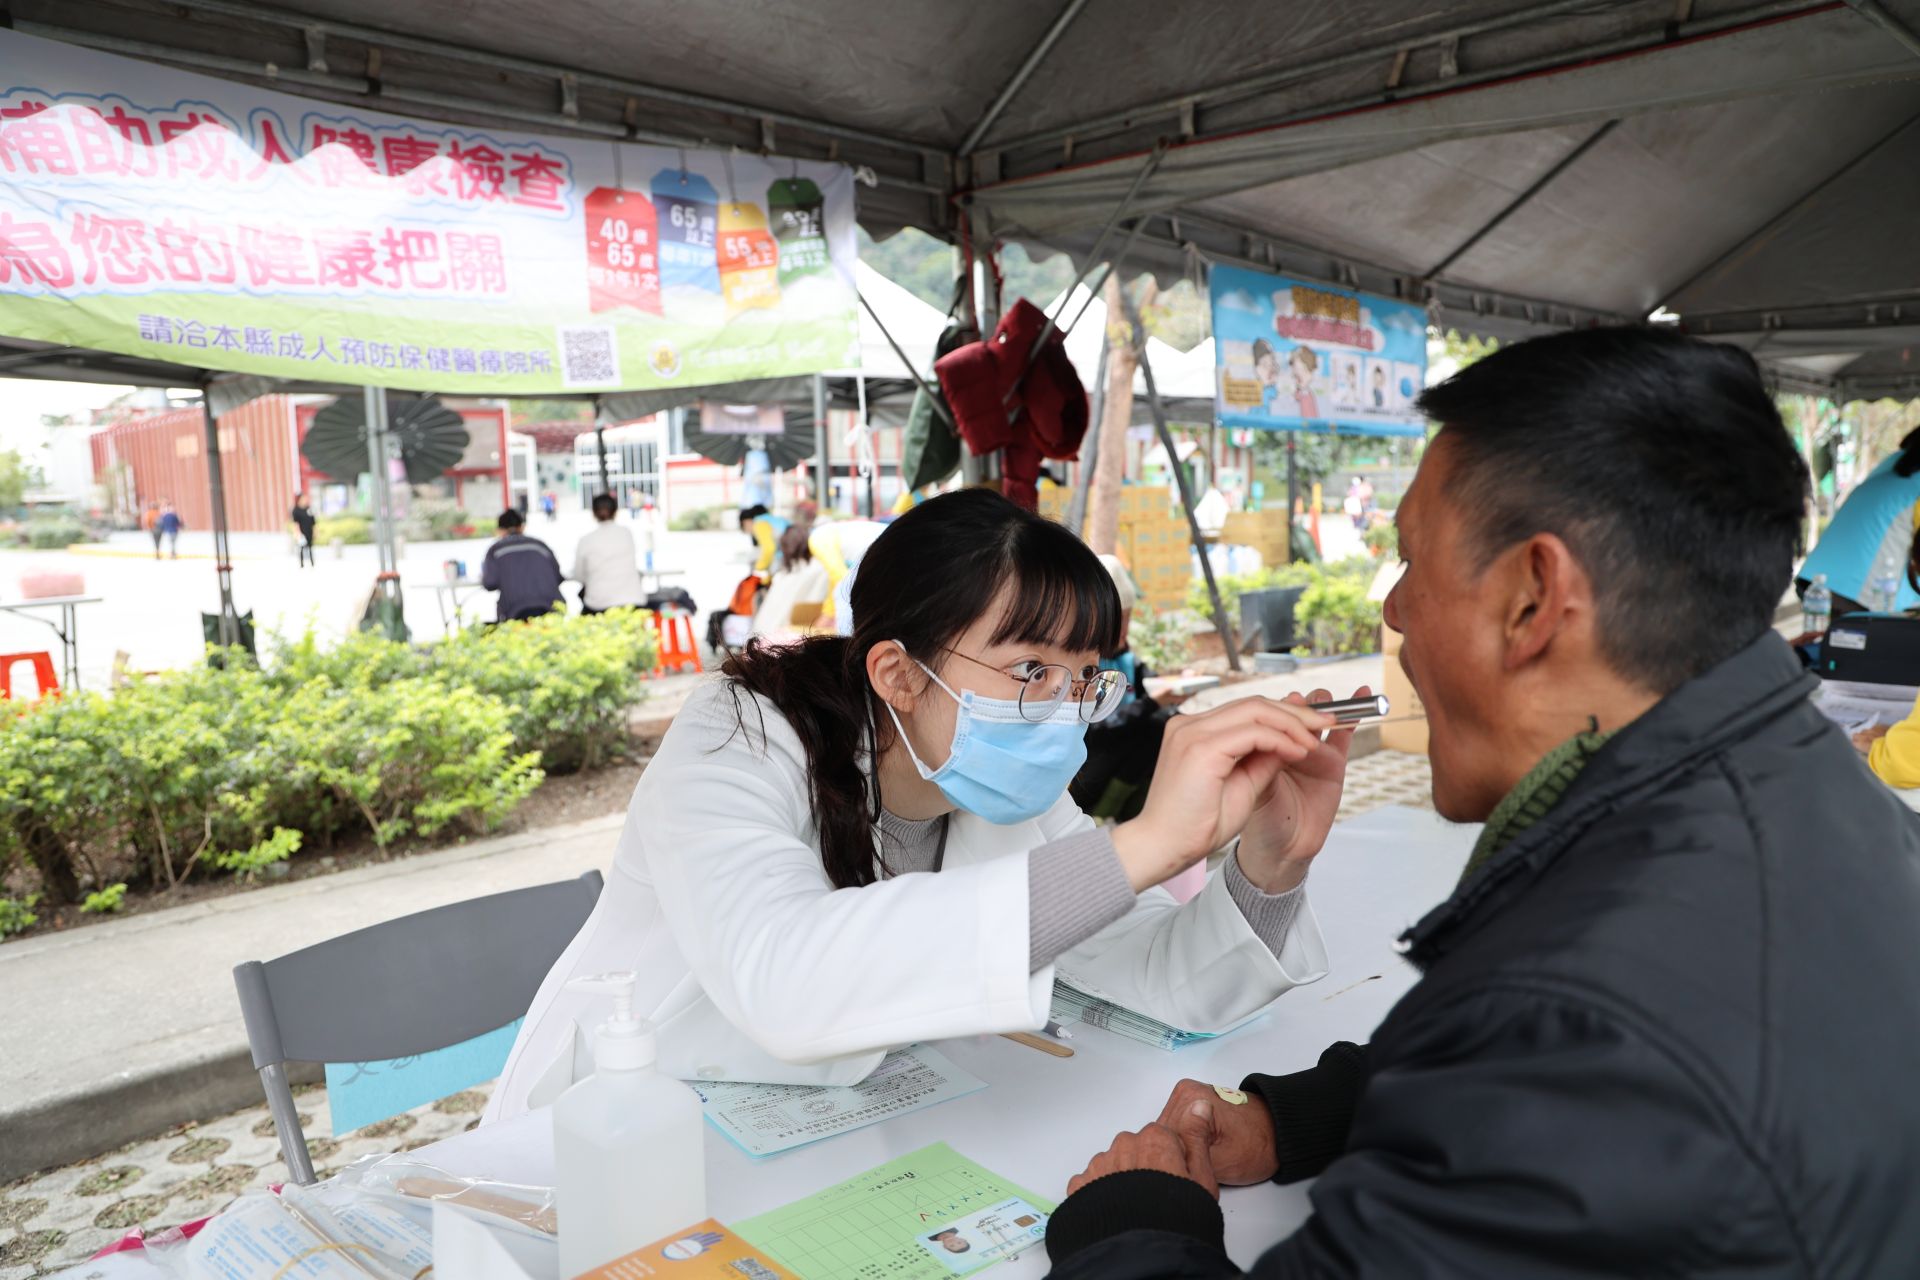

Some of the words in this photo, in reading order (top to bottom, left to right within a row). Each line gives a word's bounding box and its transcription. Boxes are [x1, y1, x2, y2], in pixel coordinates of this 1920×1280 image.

[0, 101, 566, 211] 補助成人健康檢查
[0, 212, 507, 293] 為您的健康把關
[137, 313, 552, 375] 請洽本縣成人預防保健醫療院所
